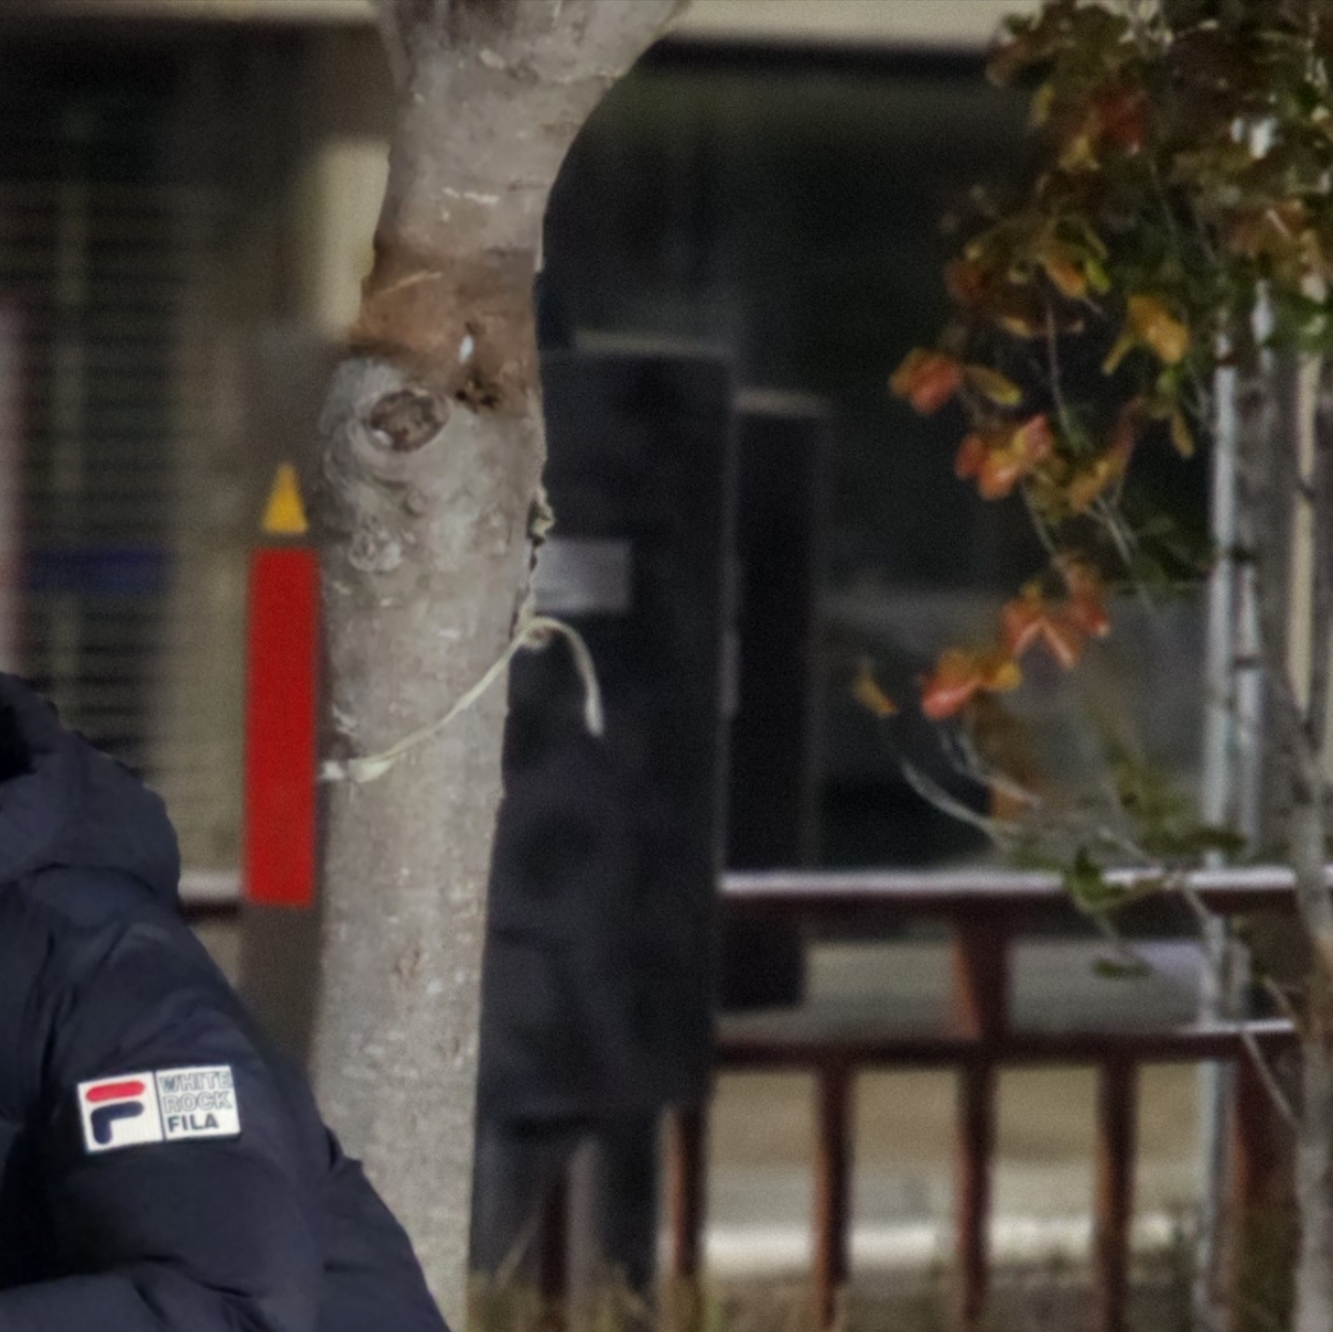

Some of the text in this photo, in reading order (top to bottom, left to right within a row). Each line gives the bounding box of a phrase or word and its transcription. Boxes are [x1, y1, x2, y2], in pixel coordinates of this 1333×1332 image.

[158, 1071, 233, 1093] WHITE
[163, 1091, 232, 1114] ROCK
[167, 1113, 219, 1132] FILA
